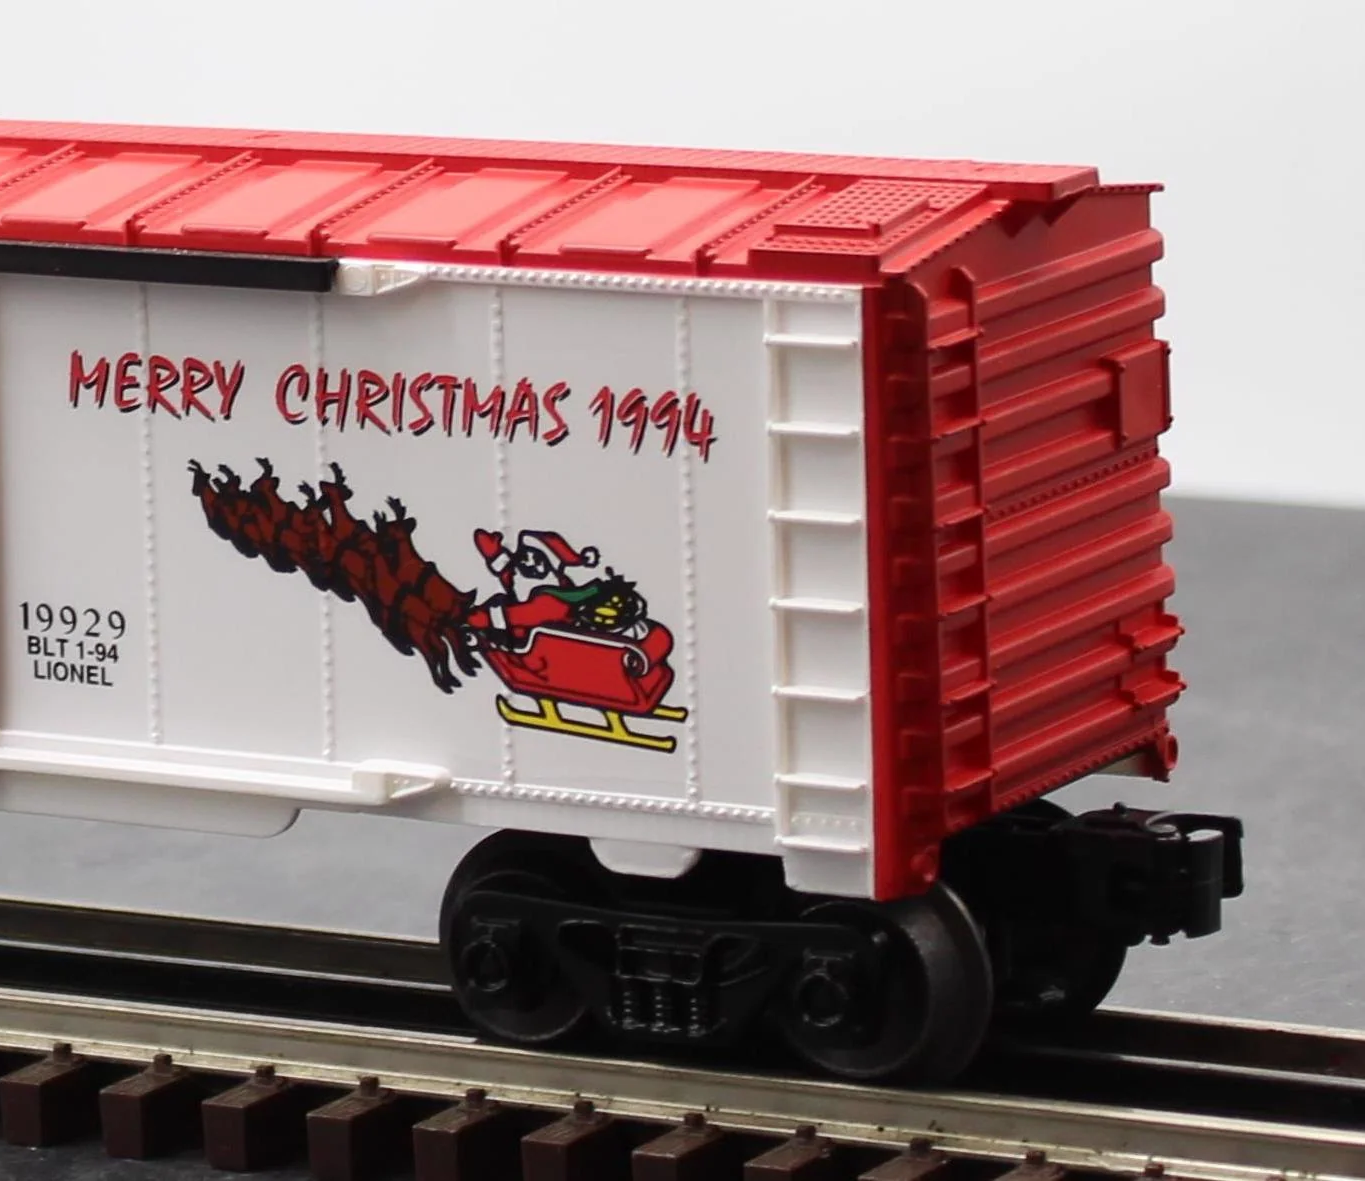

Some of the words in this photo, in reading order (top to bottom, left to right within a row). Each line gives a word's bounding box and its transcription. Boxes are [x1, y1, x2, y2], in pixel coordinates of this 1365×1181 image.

[68, 349, 246, 423] MERRY
[274, 362, 572, 447] CHRISTMAS
[588, 384, 718, 464] 1994
[19, 601, 126, 640] 19929
[27, 635, 69, 658] BLT
[75, 641, 120, 663] 1-94
[33, 660, 114, 687] LIONEL
